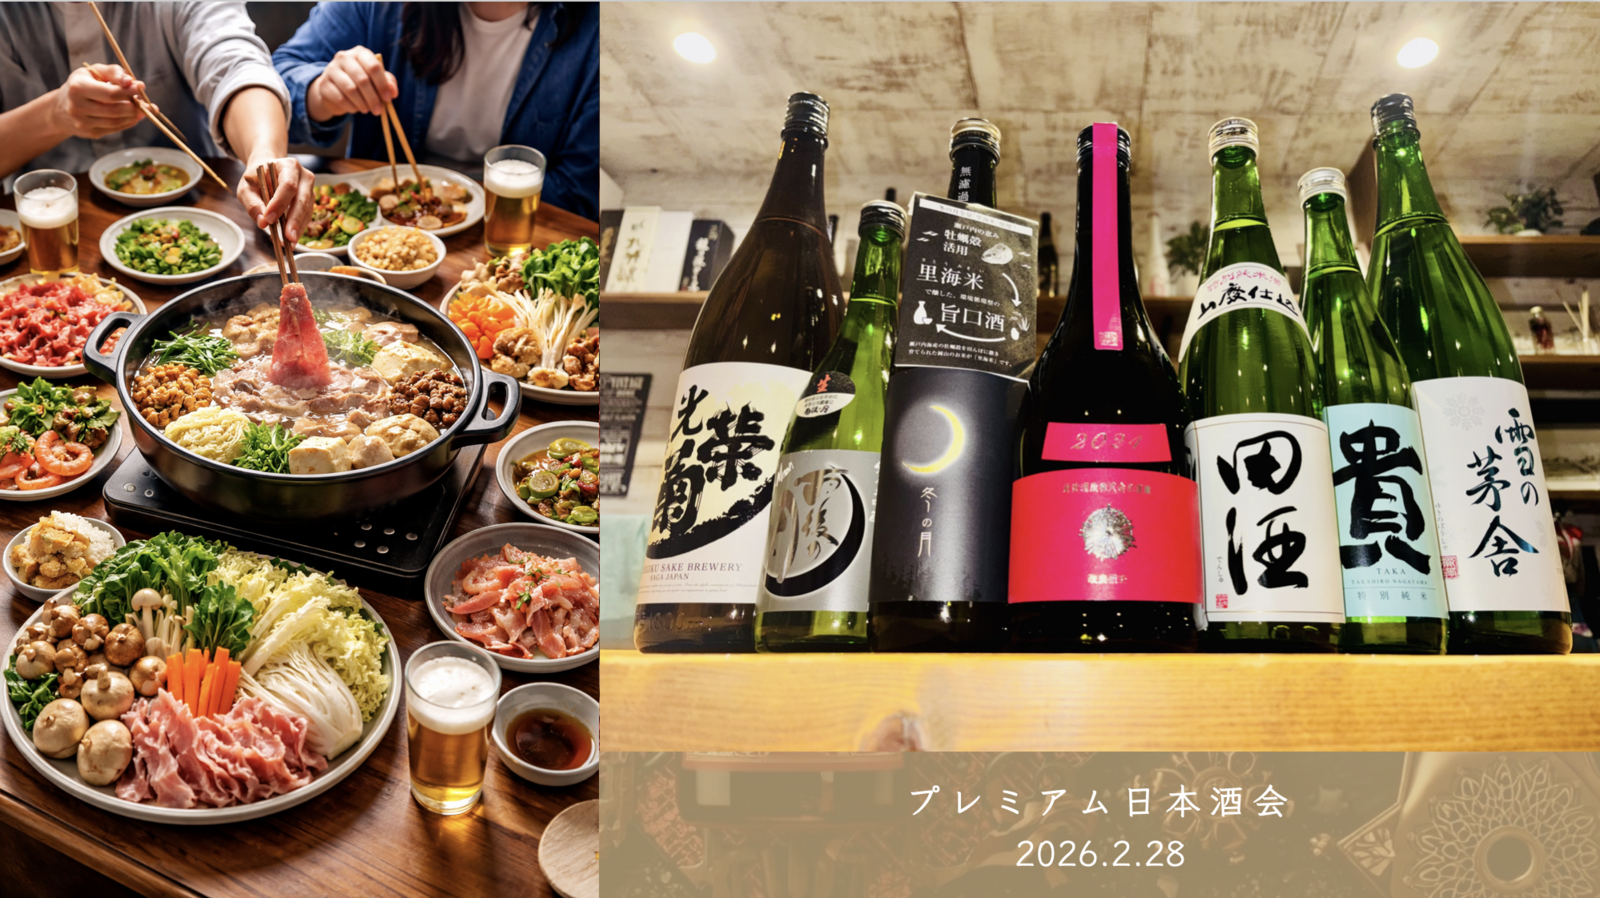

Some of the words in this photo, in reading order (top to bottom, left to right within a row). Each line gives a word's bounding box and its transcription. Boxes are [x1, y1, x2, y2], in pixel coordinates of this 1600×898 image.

[944, 229, 982, 248] 牡蠣殻
[953, 222, 1000, 239] 瀬戸内の恵み
[943, 241, 969, 257] 活用
[916, 263, 984, 290] 里海米
[941, 302, 1006, 333] 旨口酒
[816, 373, 832, 394] 生
[1332, 419, 1432, 576] 貴
[917, 486, 938, 558] 冬の月
[1216, 430, 1309, 596] 田酒
[661, 562, 684, 572] SAKE
[687, 562, 743, 572] BREWERY
[1376, 567, 1406, 576] TAKA
[650, 573, 664, 582] SAGA
[665, 573, 690, 581] JAPAN
[1357, 590, 1429, 602] 特別純米
